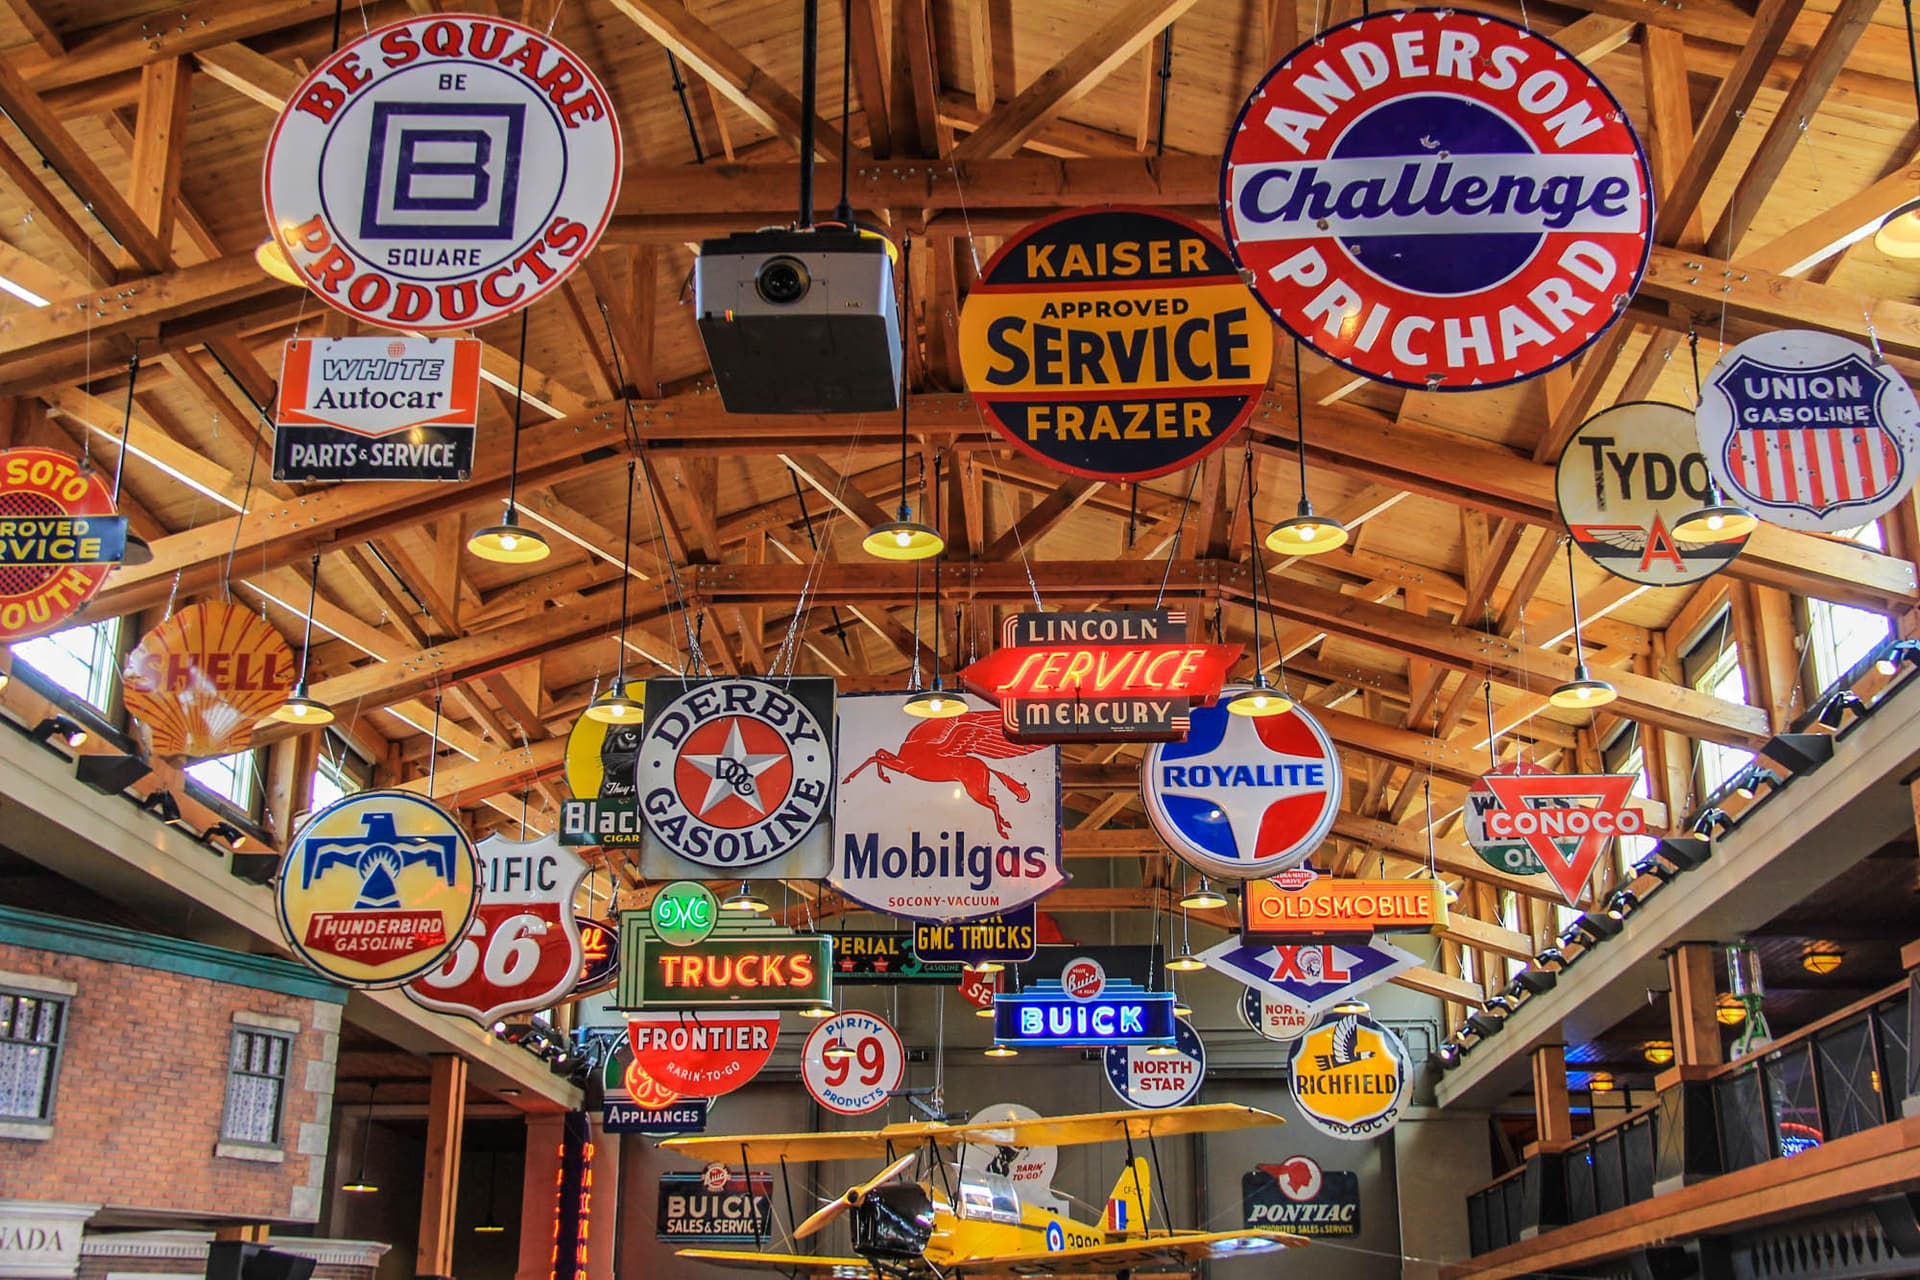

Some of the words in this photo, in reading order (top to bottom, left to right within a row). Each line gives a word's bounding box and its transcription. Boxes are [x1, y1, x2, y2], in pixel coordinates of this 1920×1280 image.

[295, 52, 374, 125] BE
[379, 21, 605, 129] SQUARE
[438, 74, 467, 92] BE
[1263, 29, 1604, 155] ANDERSON
[1238, 162, 1631, 230] Challenge
[281, 214, 588, 322] PRODUCTS
[387, 248, 481, 267] SQUARE
[1026, 238, 1210, 279] KAISER
[1040, 298, 1190, 319] APPROVED
[1268, 240, 1617, 369] PRICHARD
[985, 307, 1251, 385] SERVICE
[323, 358, 445, 381] WHITE
[313, 386, 444, 410] Autocar
[1744, 376, 1863, 399] UNION
[1026, 402, 1213, 441] FRAZER
[1744, 405, 1870, 423] GASOLINE
[290, 443, 357, 468] PARTS
[359, 448, 368, 461] &
[369, 443, 454, 467] SERVICE
[6, 458, 89, 501] SOTO
[1028, 618, 1158, 642] LINCOLN
[138, 652, 287, 693] SHELL
[997, 649, 1206, 691] SERVICE
[652, 684, 821, 750] DERBY
[1026, 700, 1172, 725] MERCURY
[1163, 764, 1324, 787] ROYALITE
[645, 777, 825, 863] GASOLINE
[1490, 810, 1640, 835] CONOCO
[843, 831, 1047, 891] Mobilgas
[658, 897, 709, 929] GMC
[888, 895, 1000, 907] SOCONY-VACUUM
[1260, 895, 1430, 919] OLDSMOBILE
[314, 914, 442, 939] THUNDERBIRD
[918, 926, 954, 950] GMC
[959, 926, 1032, 950] TRUCKS
[335, 936, 415, 951] GASOLINE
[423, 913, 547, 989] 66
[658, 954, 813, 988] TRUCKS
[825, 1017, 883, 1036] PURITY
[1021, 1006, 1144, 1034] BUICK
[1270, 1016, 1305, 1026] STAR
[637, 1026, 768, 1051] FRONTIER
[822, 1037, 885, 1087] 99
[1132, 1060, 1192, 1074] NORTH
[1140, 1077, 1185, 1091] STAR
[1296, 1074, 1396, 1095] RICHFIELD
[822, 1087, 884, 1107] PRODUCTS
[667, 1195, 762, 1219] BUICK
[1247, 1204, 1356, 1222] PONTIAC
[667, 1219, 705, 1233] SALES
[704, 1221, 710, 1233] &
[713, 1219, 762, 1233] SERVICE
